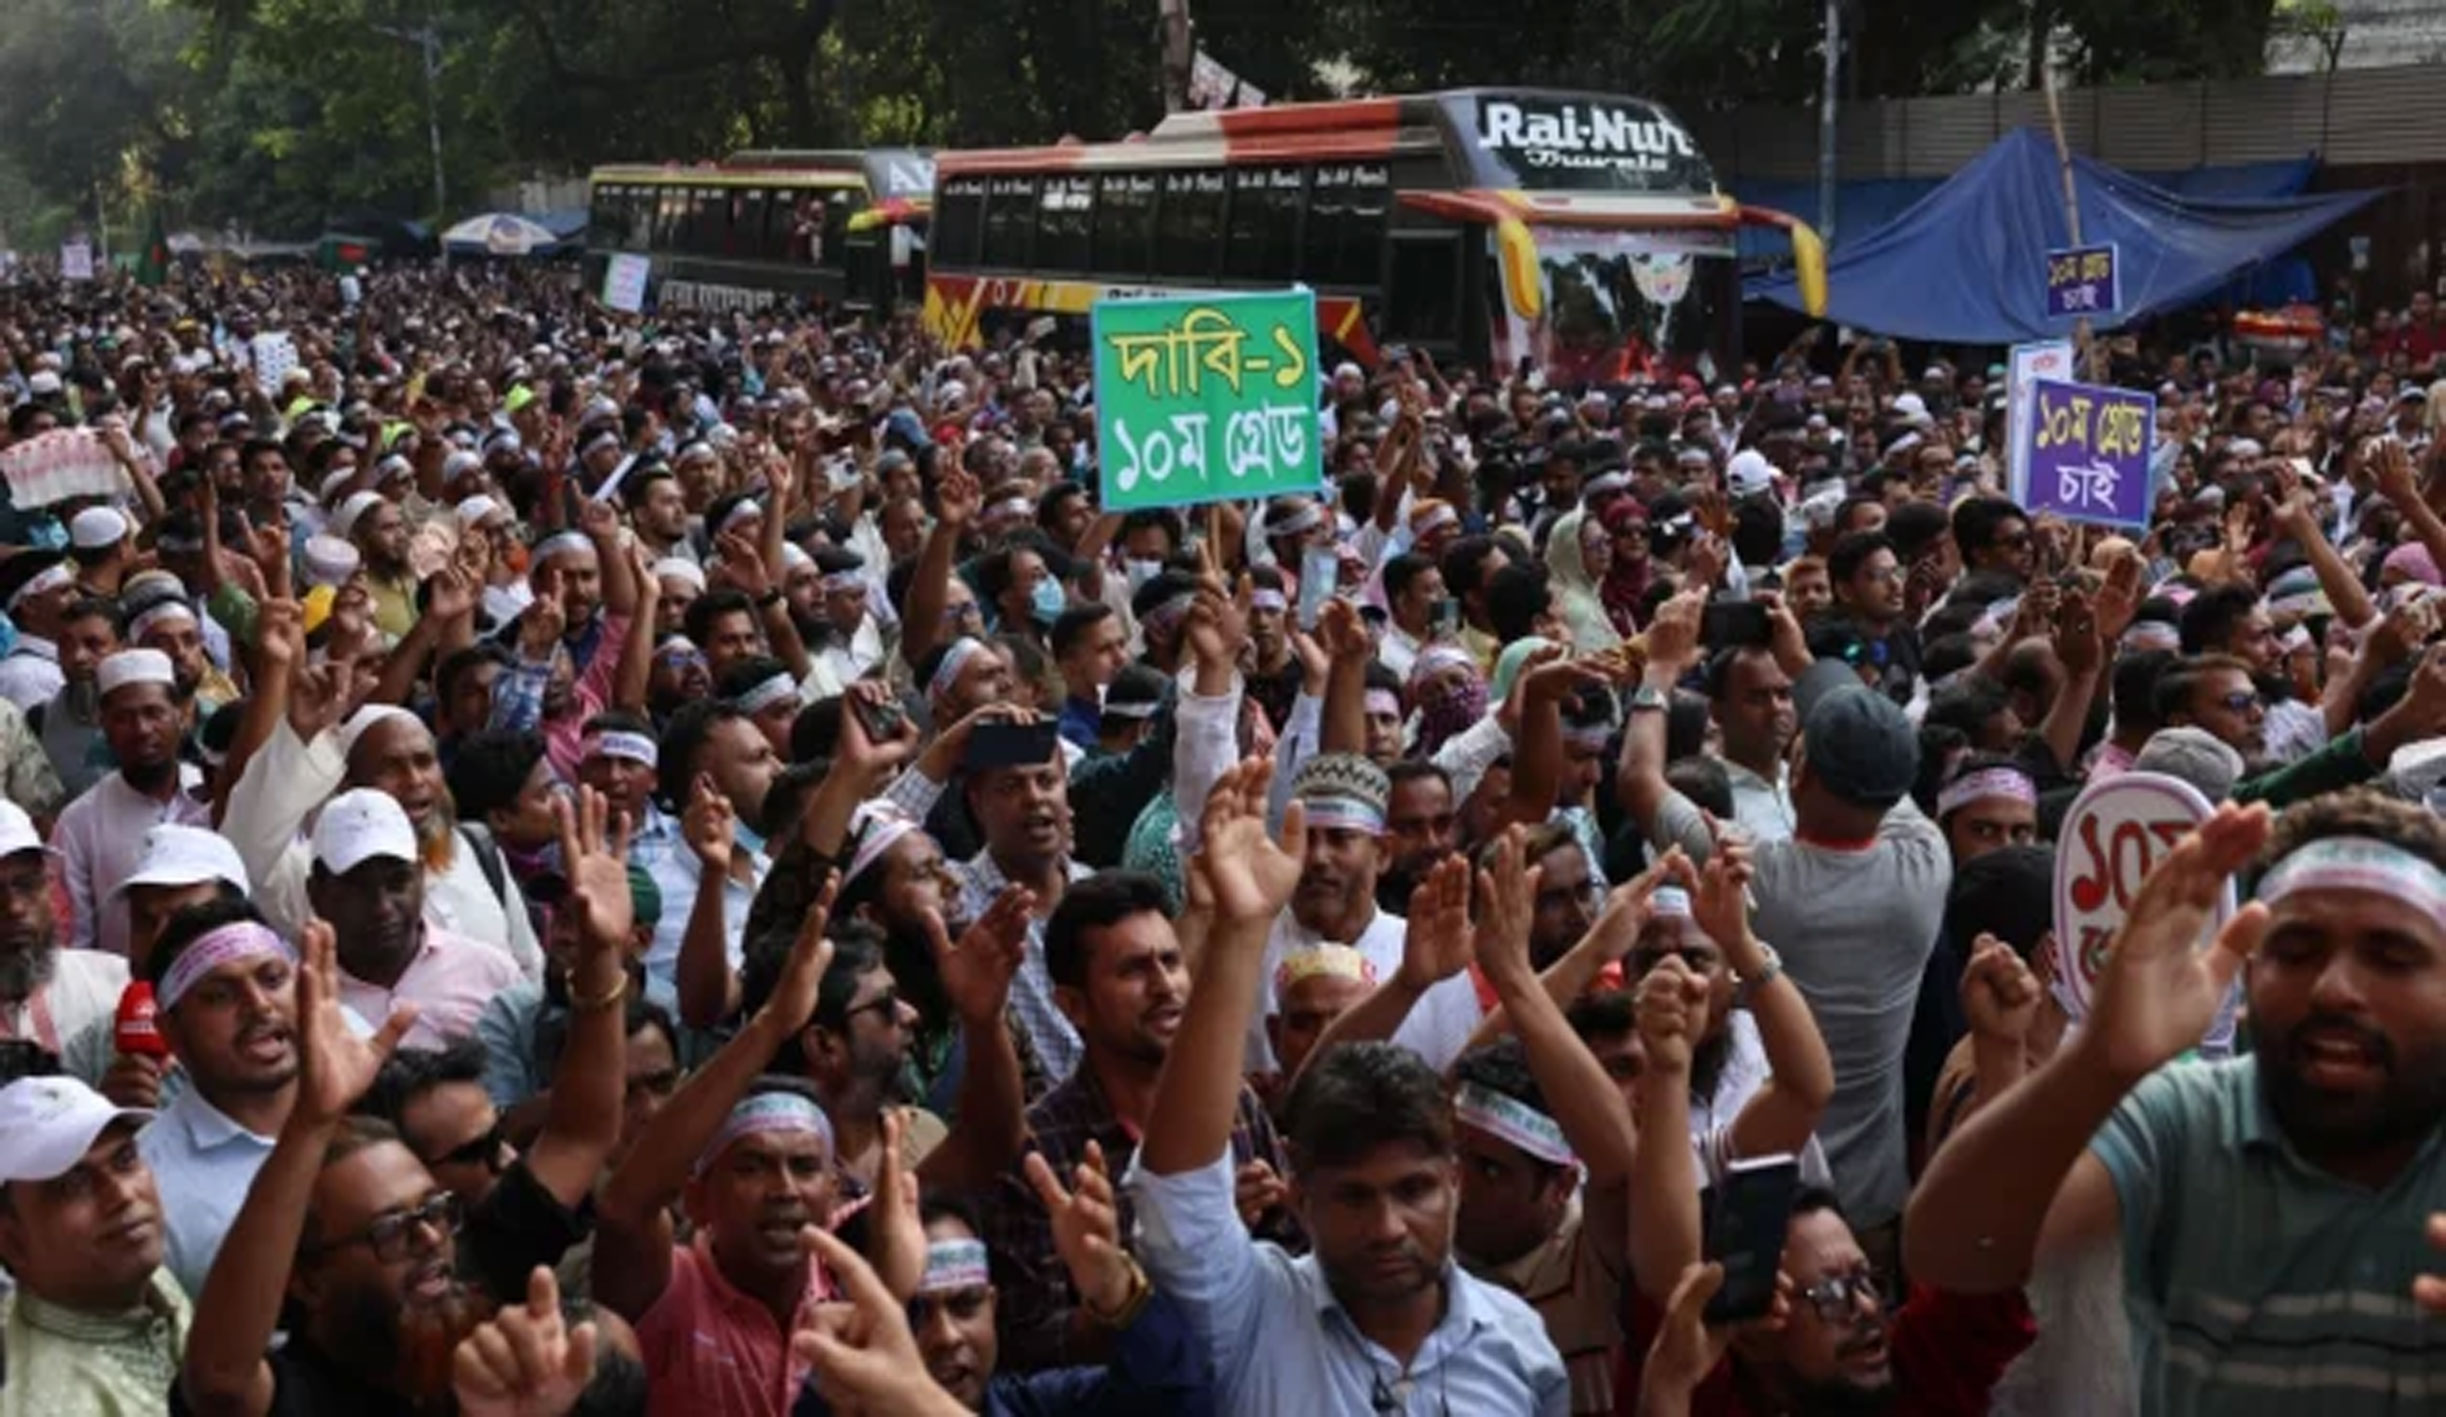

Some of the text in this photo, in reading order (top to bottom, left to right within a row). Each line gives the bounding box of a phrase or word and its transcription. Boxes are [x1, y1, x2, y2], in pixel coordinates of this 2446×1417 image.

[1107, 307, 1306, 398] দাবি-১
[1113, 397, 1310, 492] ১০ম গ্রেড
[2036, 392, 2147, 461] ১০ম গ্রেড
[2055, 456, 2122, 514] চাই
